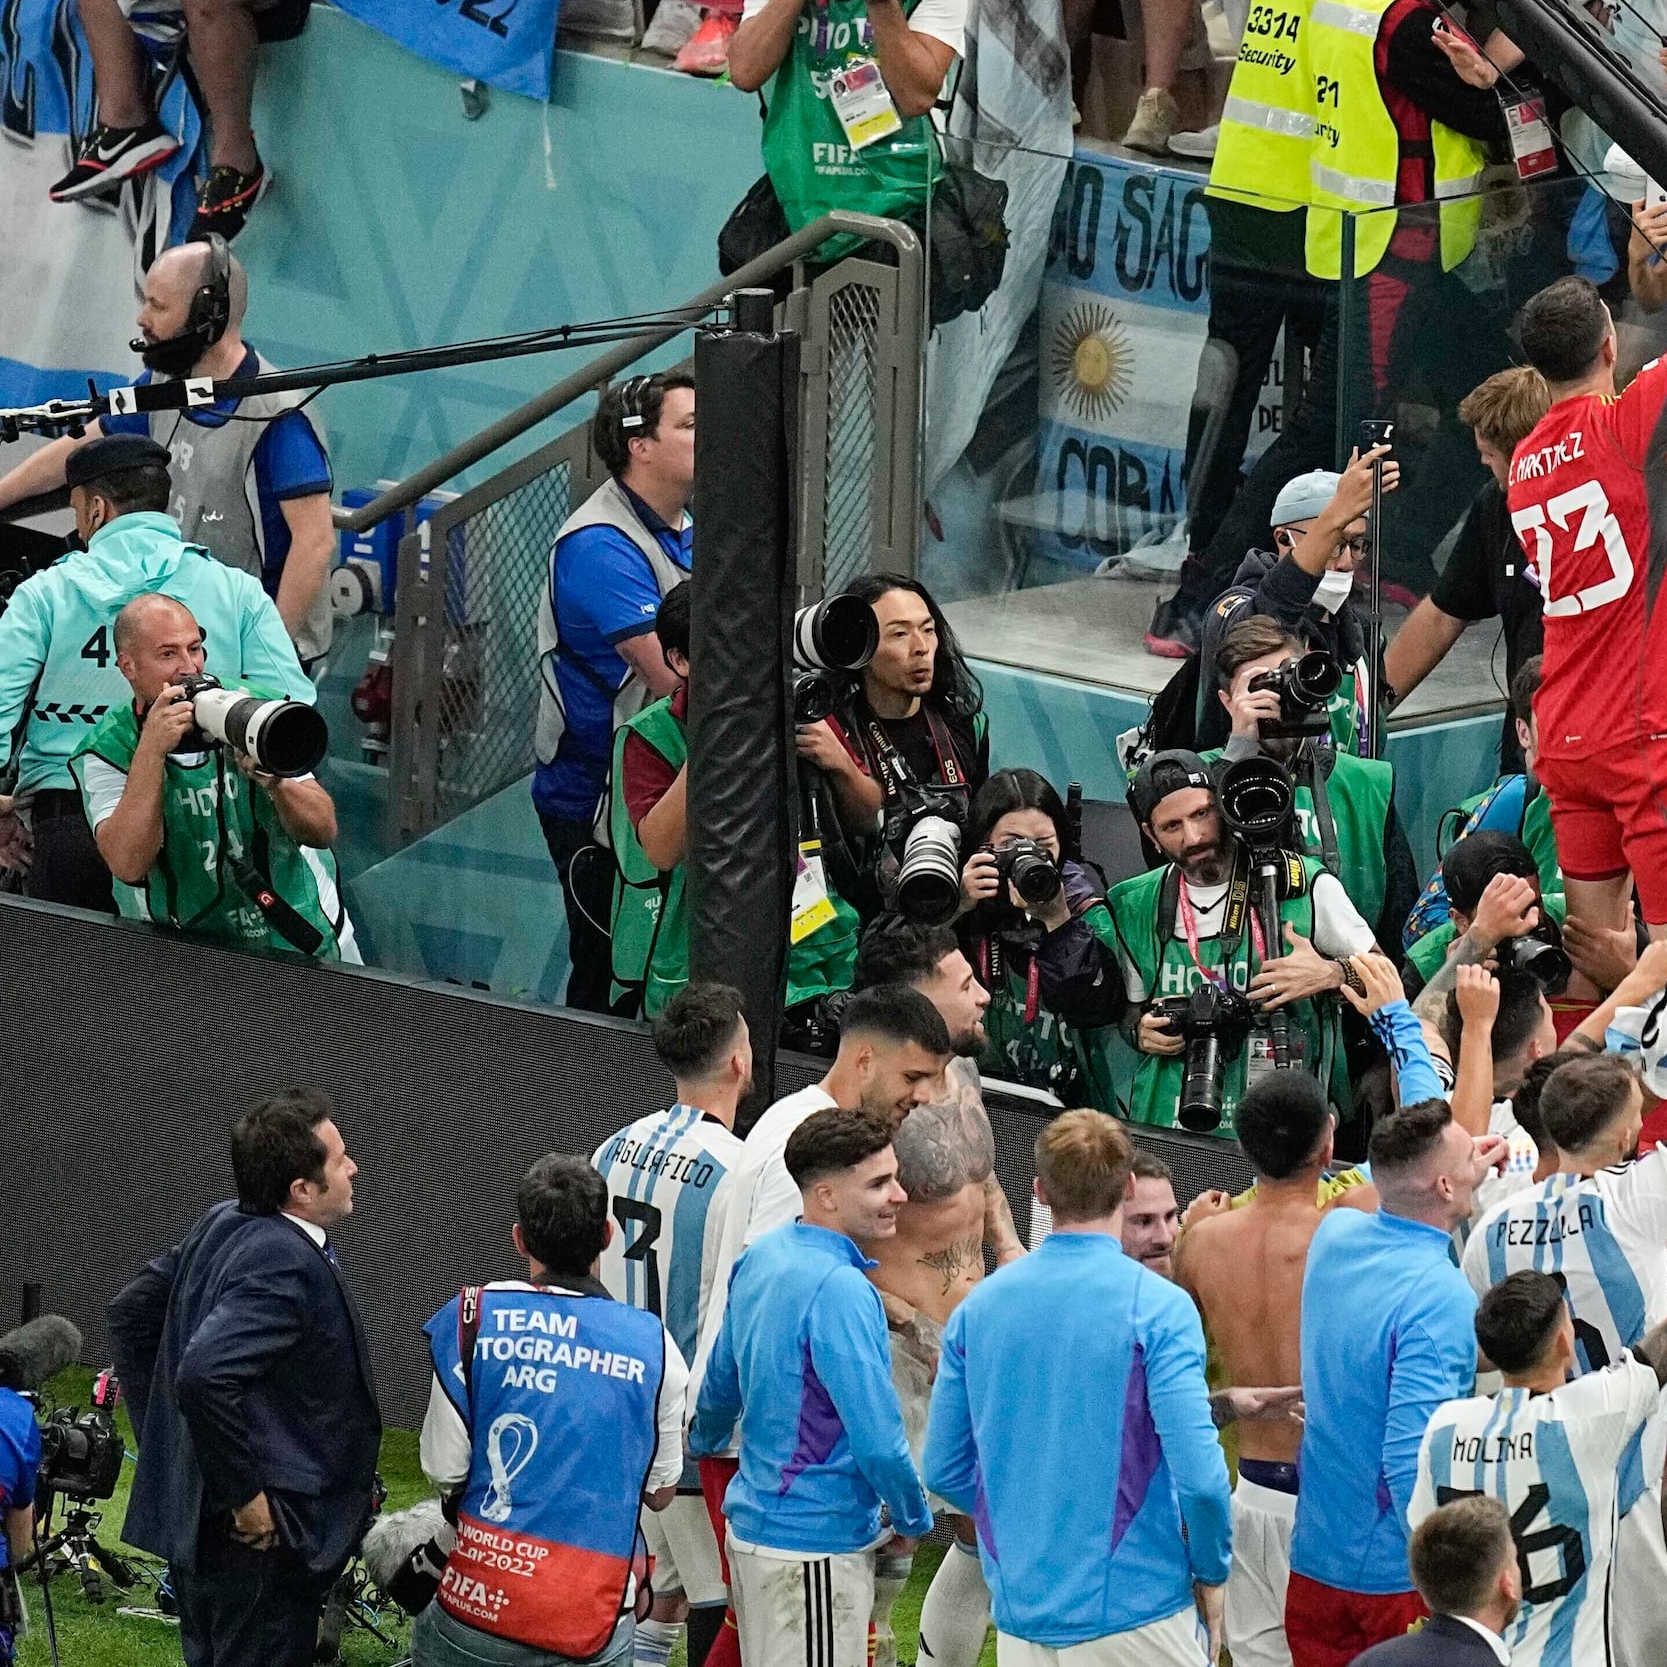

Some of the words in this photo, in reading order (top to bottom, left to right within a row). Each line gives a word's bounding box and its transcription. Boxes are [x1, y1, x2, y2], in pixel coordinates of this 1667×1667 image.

[1248, 6, 1300, 45] 3314
[1238, 42, 1297, 77] Security
[943, 759, 959, 784] EOS
[1290, 857, 1301, 888] Nikon
[1229, 903, 1241, 931] Nikon
[491, 1308, 578, 1341] TEAM
[455, 1336, 646, 1384] TOGRAPHER
[500, 1364, 558, 1393] ARG
[1453, 1432, 1534, 1464] MOLINA
[463, 1524, 515, 1552] WORLD
[514, 1542, 550, 1563] CUP
[442, 1566, 488, 1606] FIFA
